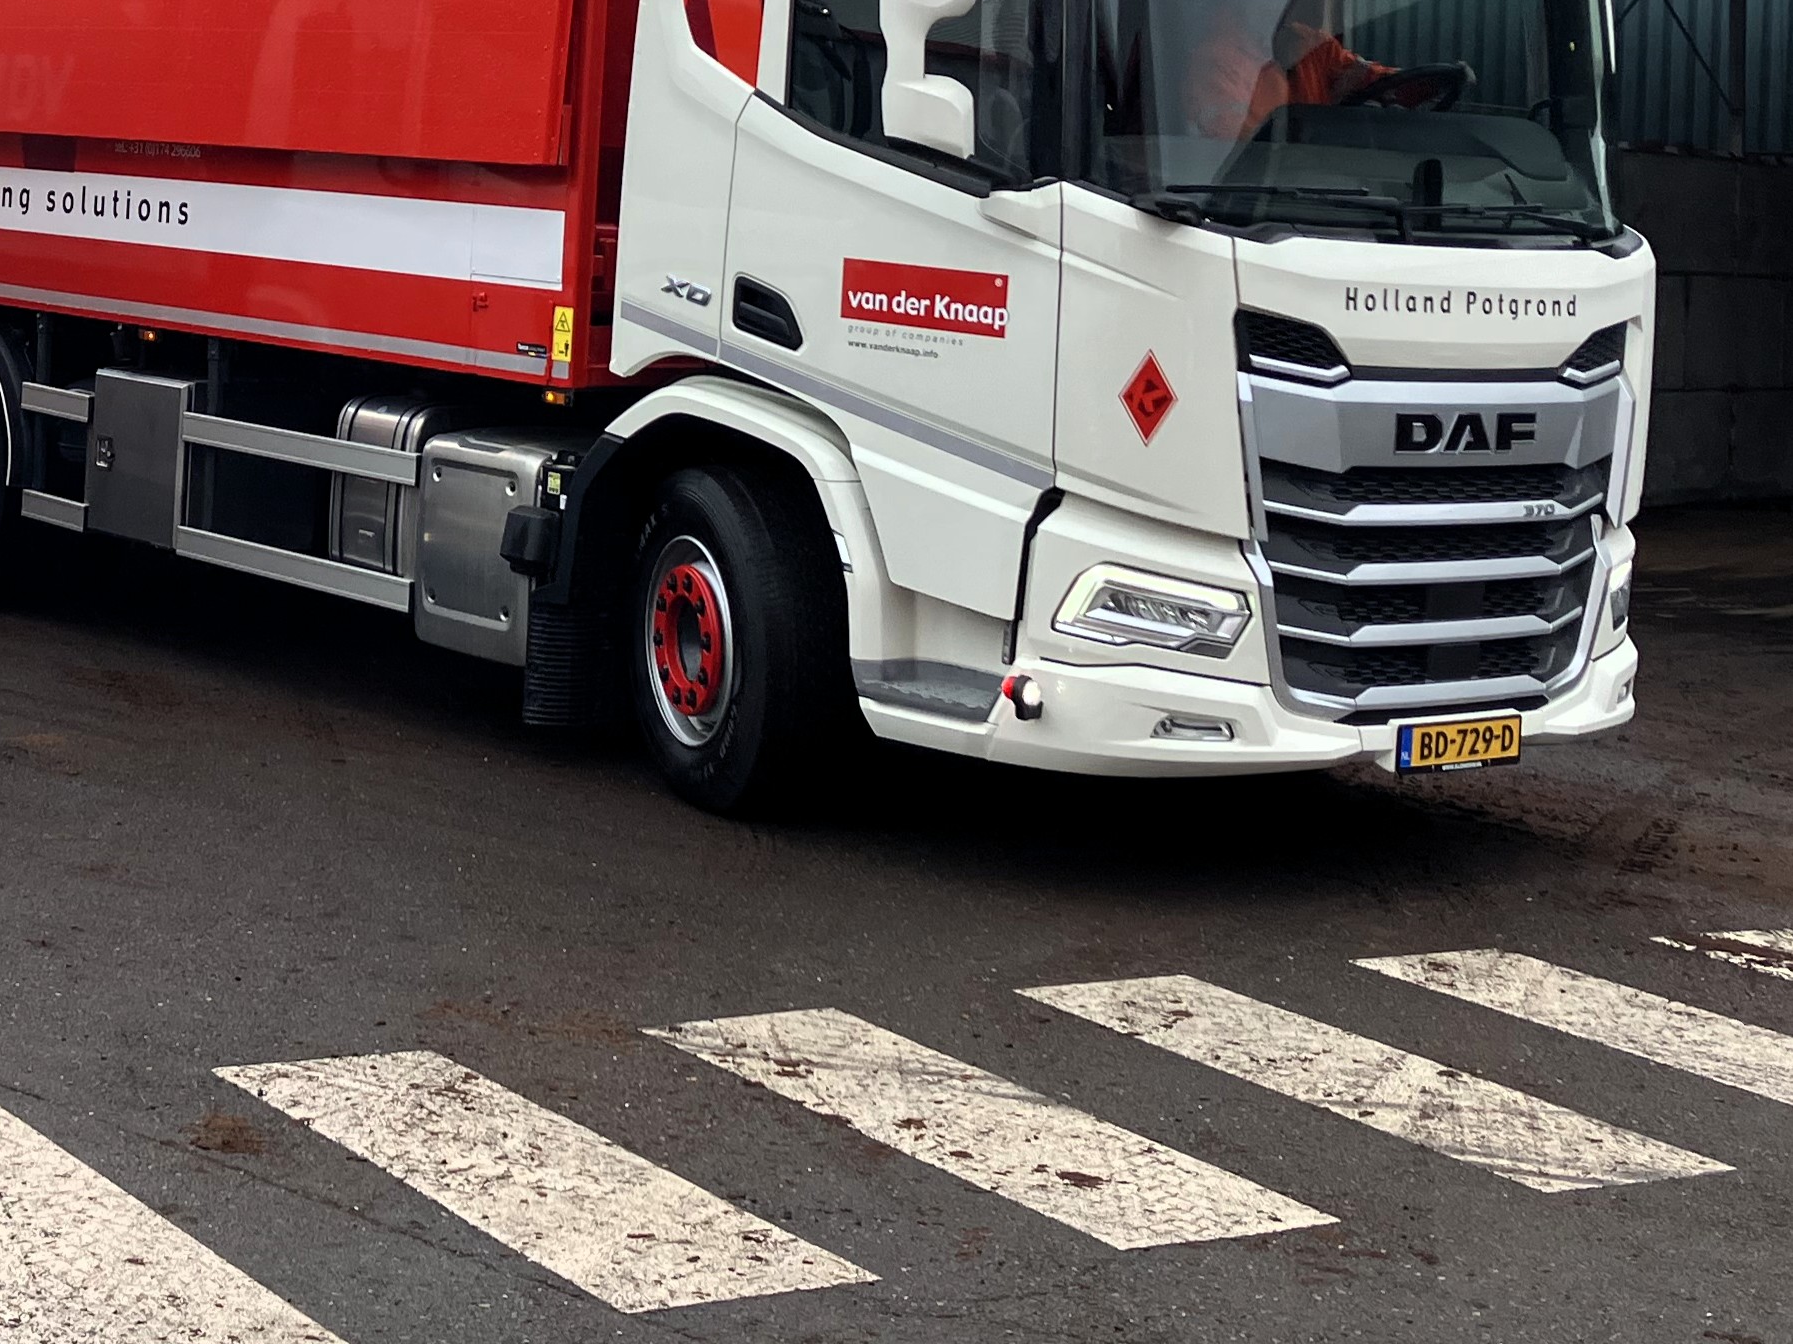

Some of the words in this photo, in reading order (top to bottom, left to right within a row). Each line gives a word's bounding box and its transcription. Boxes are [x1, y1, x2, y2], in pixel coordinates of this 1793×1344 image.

[46, 186, 189, 225] solutions
[848, 290, 888, 312] van
[892, 290, 930, 316] der
[934, 294, 1009, 330] Knaap
[1345, 287, 1451, 313] Holland
[1466, 291, 1577, 320] Potgrond
[847, 324, 879, 336] group
[885, 329, 897, 338] of
[902, 331, 964, 346] companies
[848, 340, 939, 358] www.vanderknaap.info
[1393, 412, 1537, 455] DAF
[1420, 724, 1514, 761] BD-729-D
